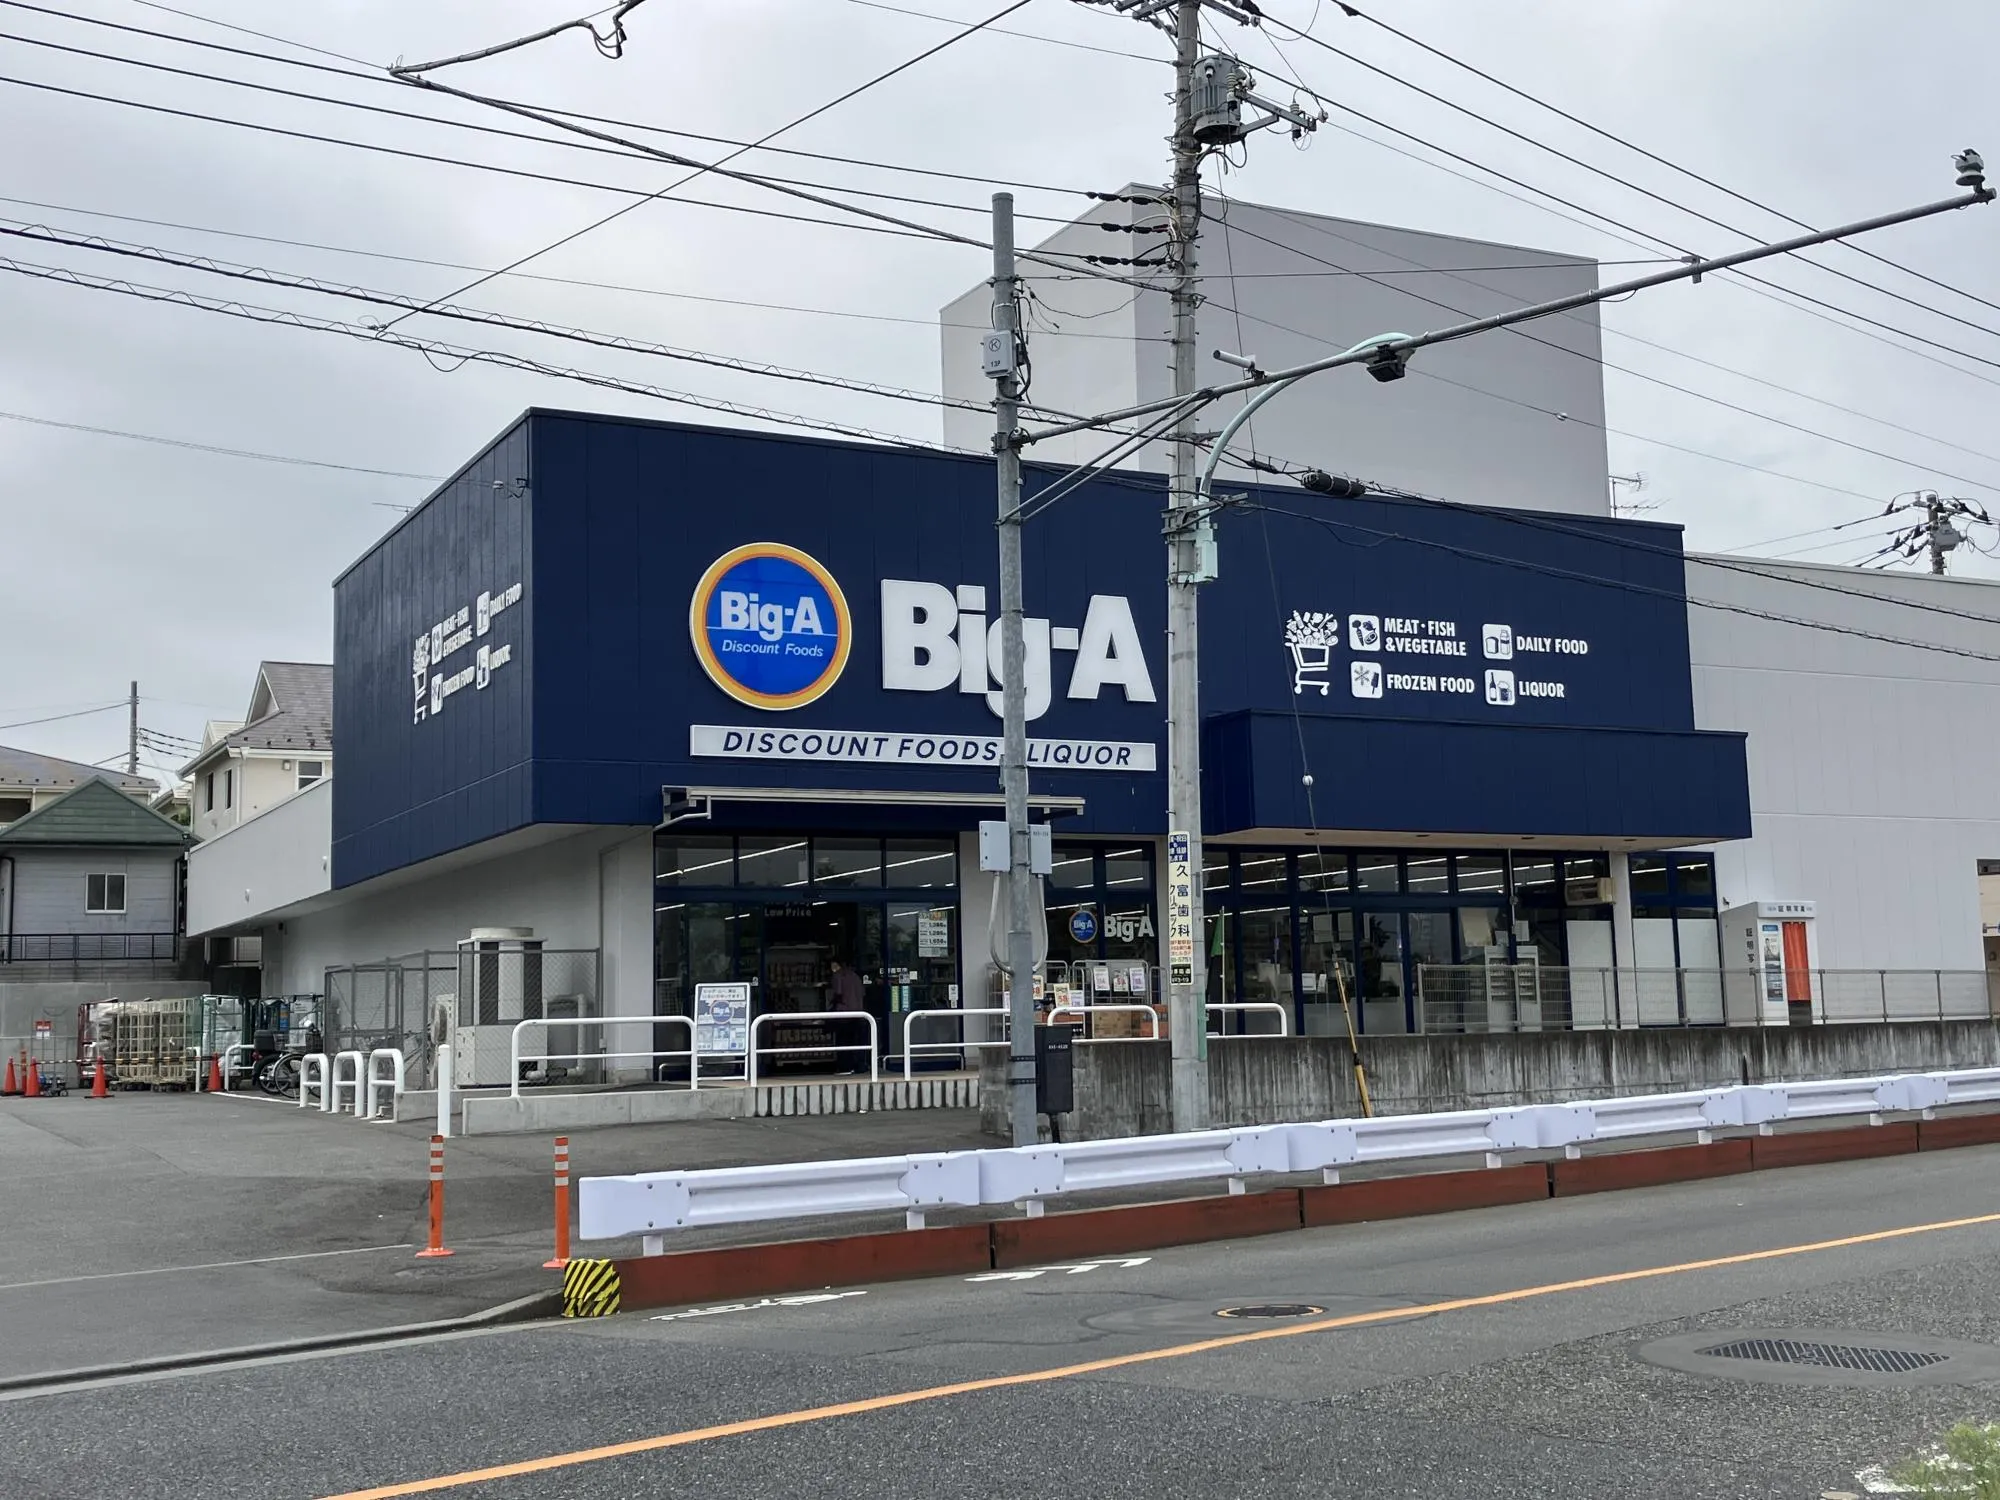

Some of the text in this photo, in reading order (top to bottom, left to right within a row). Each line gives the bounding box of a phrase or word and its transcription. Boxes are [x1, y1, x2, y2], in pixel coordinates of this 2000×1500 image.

[721, 592, 823, 641] Big-A
[722, 640, 824, 657] Discount Foods
[881, 579, 1156, 722] Big-A
[1385, 636, 1467, 656] &VEGETABLE
[1516, 635, 1588, 655] DAILY FOOD
[1387, 674, 1475, 694] FROZEN FOOD
[1519, 681, 1565, 698] LIQUOR
[722, 731, 1131, 766] DISCOUNT FOODS LIQUOR
[1169, 884, 1177, 938] クリニック
[1176, 864, 1190, 937] 久富歯科
[1073, 919, 1094, 930] Big-A
[1104, 916, 1155, 943] Big-A
